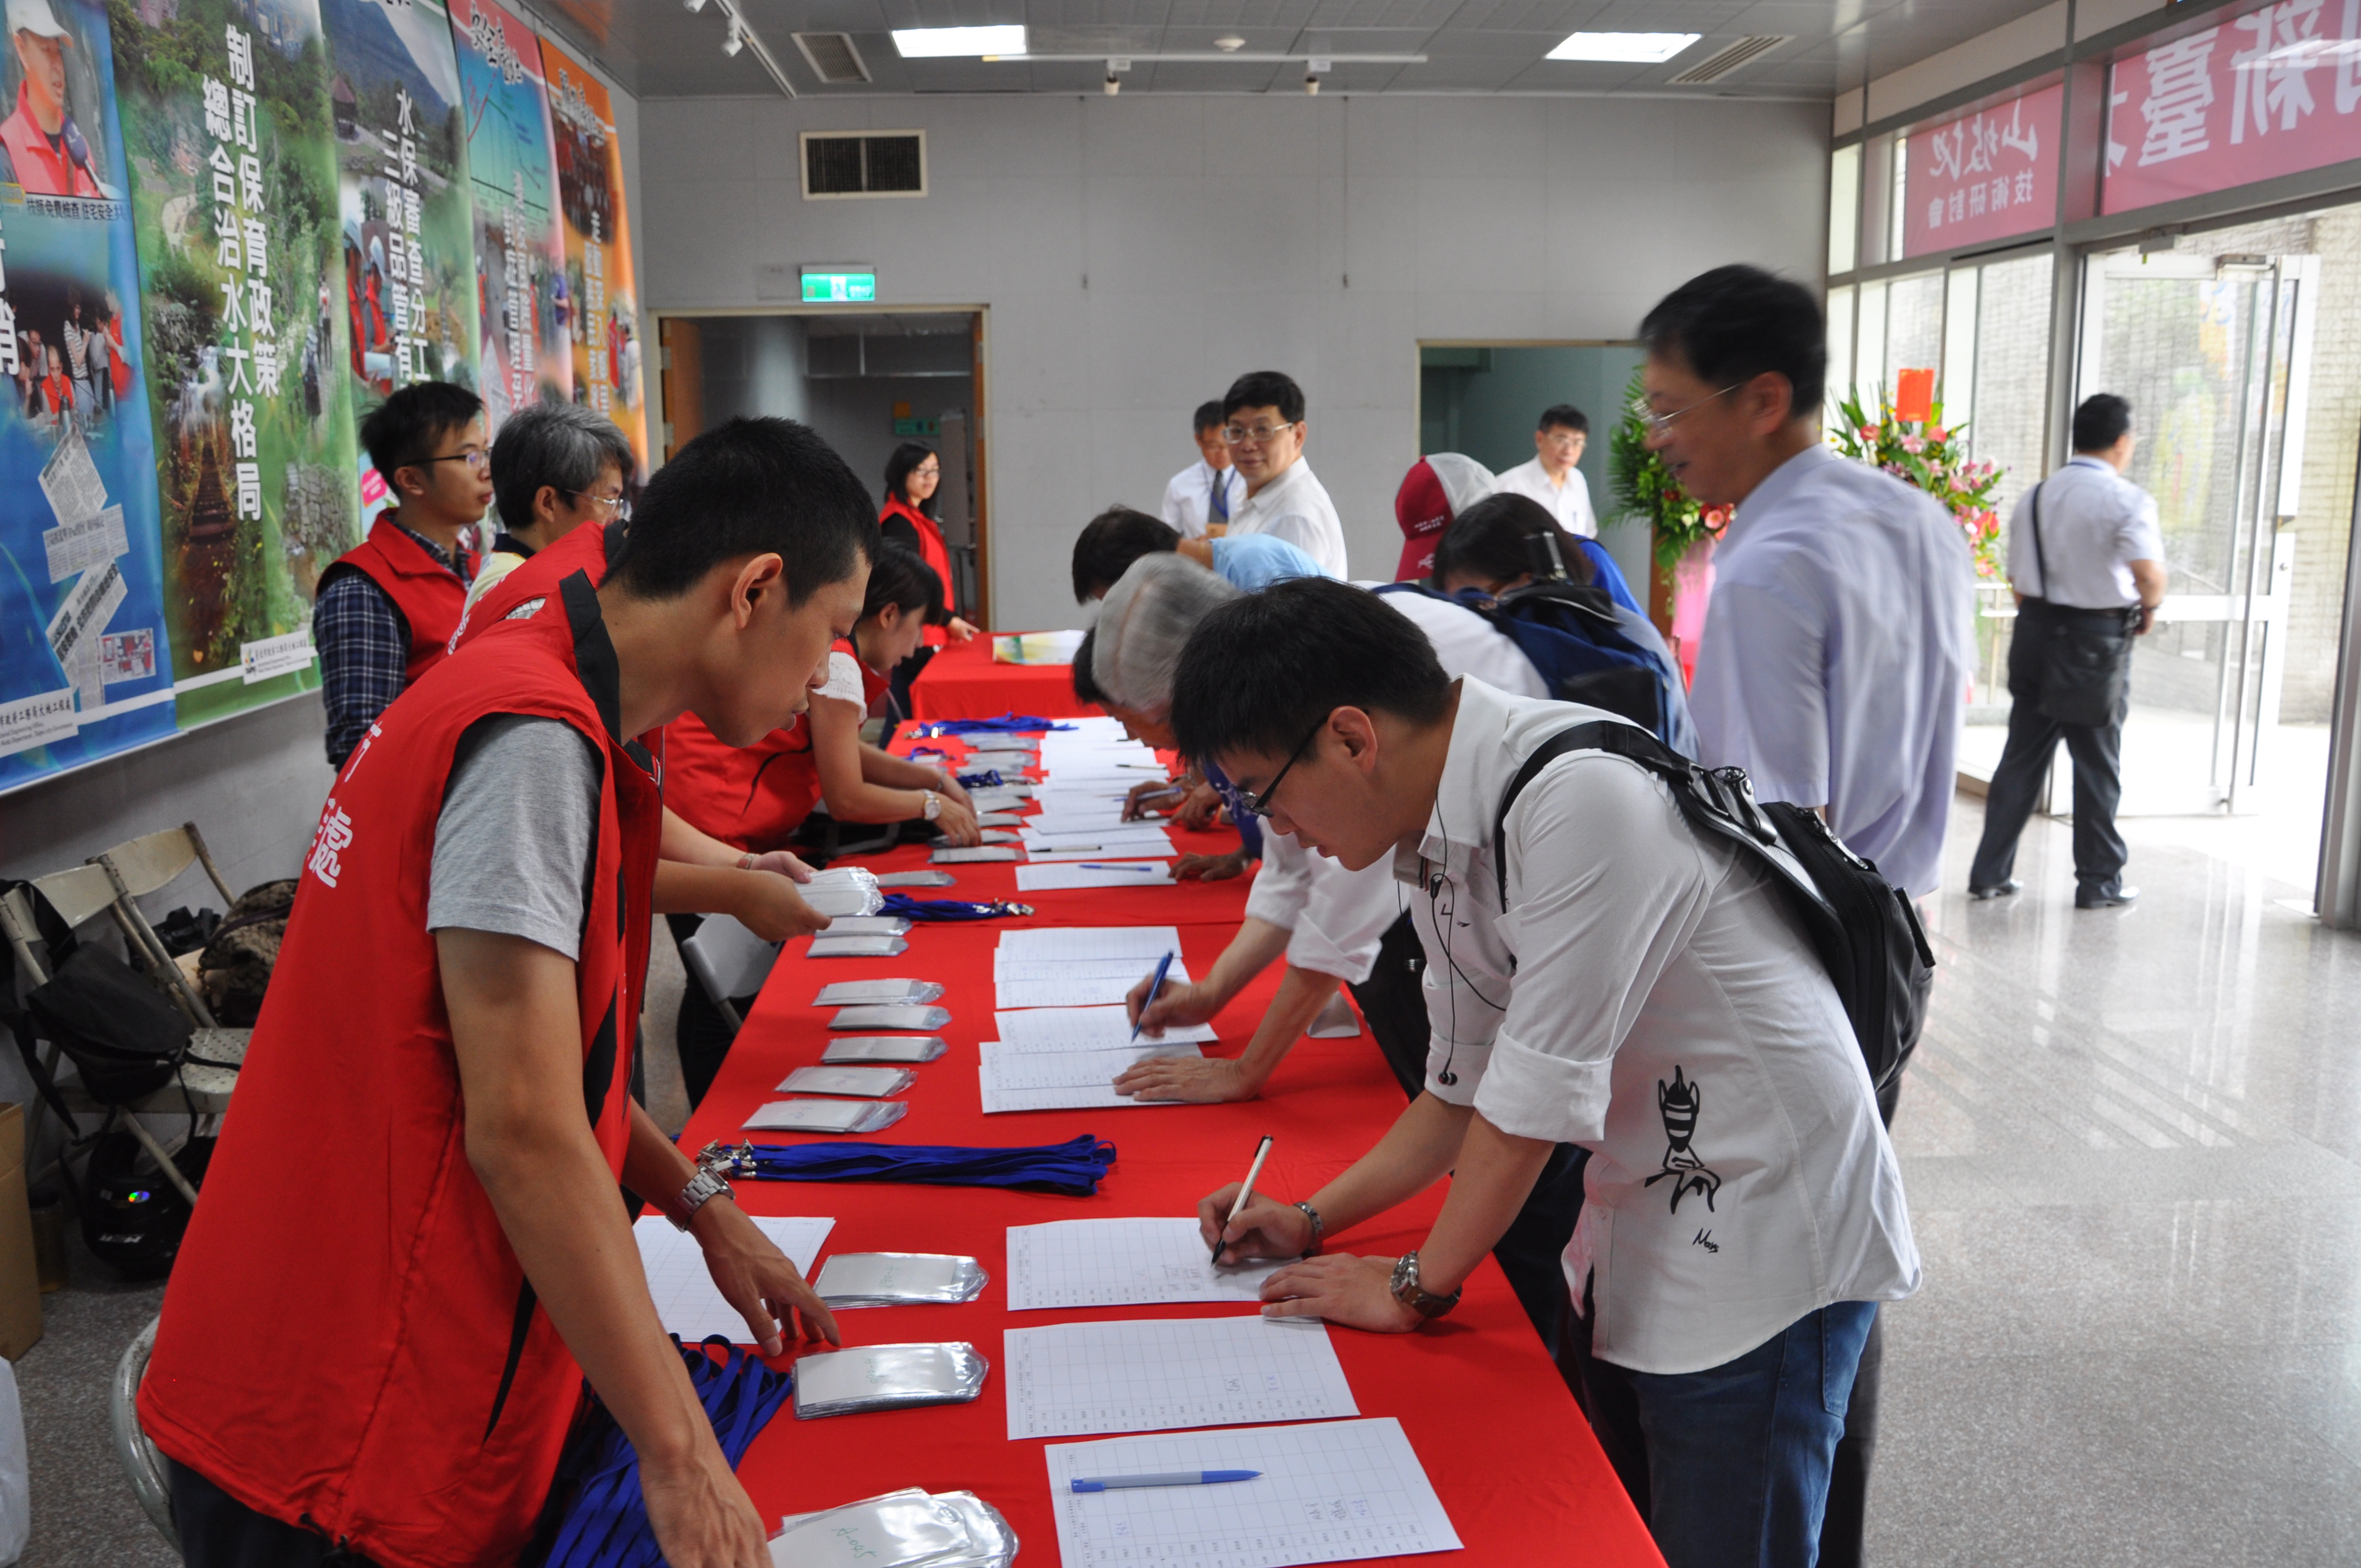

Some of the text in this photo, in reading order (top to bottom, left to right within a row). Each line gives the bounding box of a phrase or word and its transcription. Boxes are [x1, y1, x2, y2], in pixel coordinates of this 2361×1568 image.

[202, 74, 262, 521] 總合治水大格局
[226, 24, 279, 399] 制訂保育政策
[382, 129, 412, 388] 三級品管有
[831, 1527, 878, 1559] A-045
